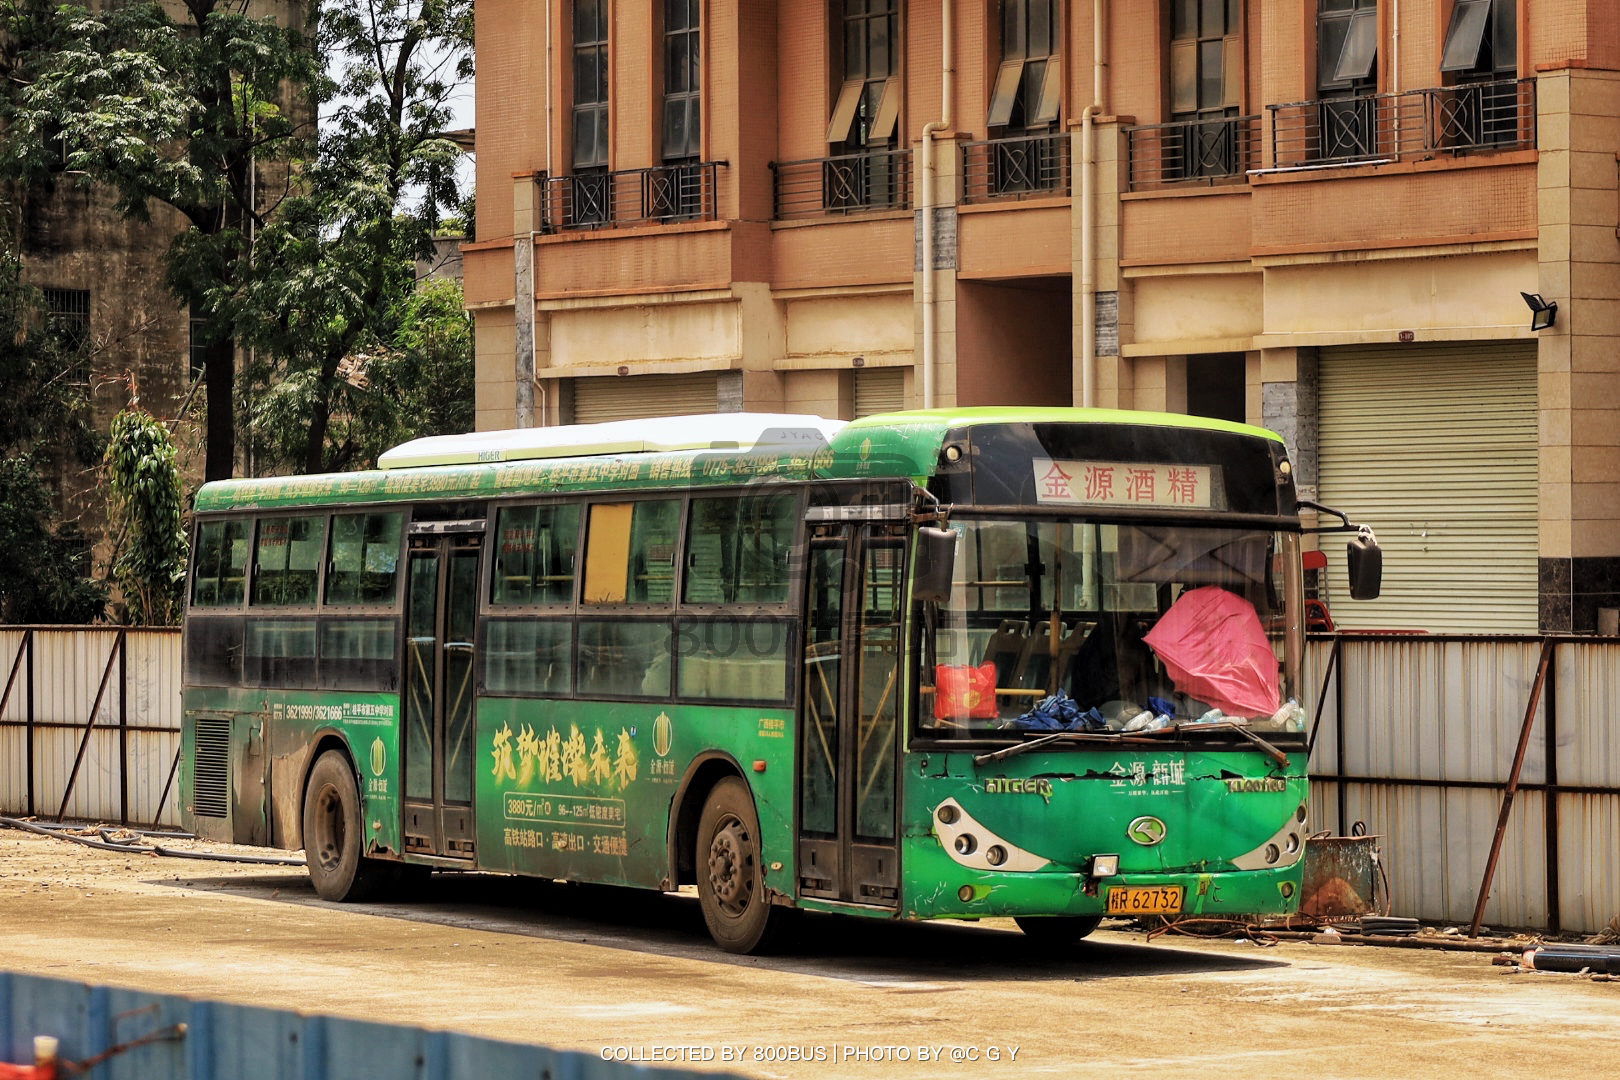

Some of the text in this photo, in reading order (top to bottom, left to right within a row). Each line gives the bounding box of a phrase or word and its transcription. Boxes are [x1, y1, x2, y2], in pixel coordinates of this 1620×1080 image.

[478, 450, 500, 461] HIGER
[1039, 463, 1199, 504] 金源酒精
[286, 704, 343, 720] 3621999/3621666
[984, 778, 1050, 794] HIGER
